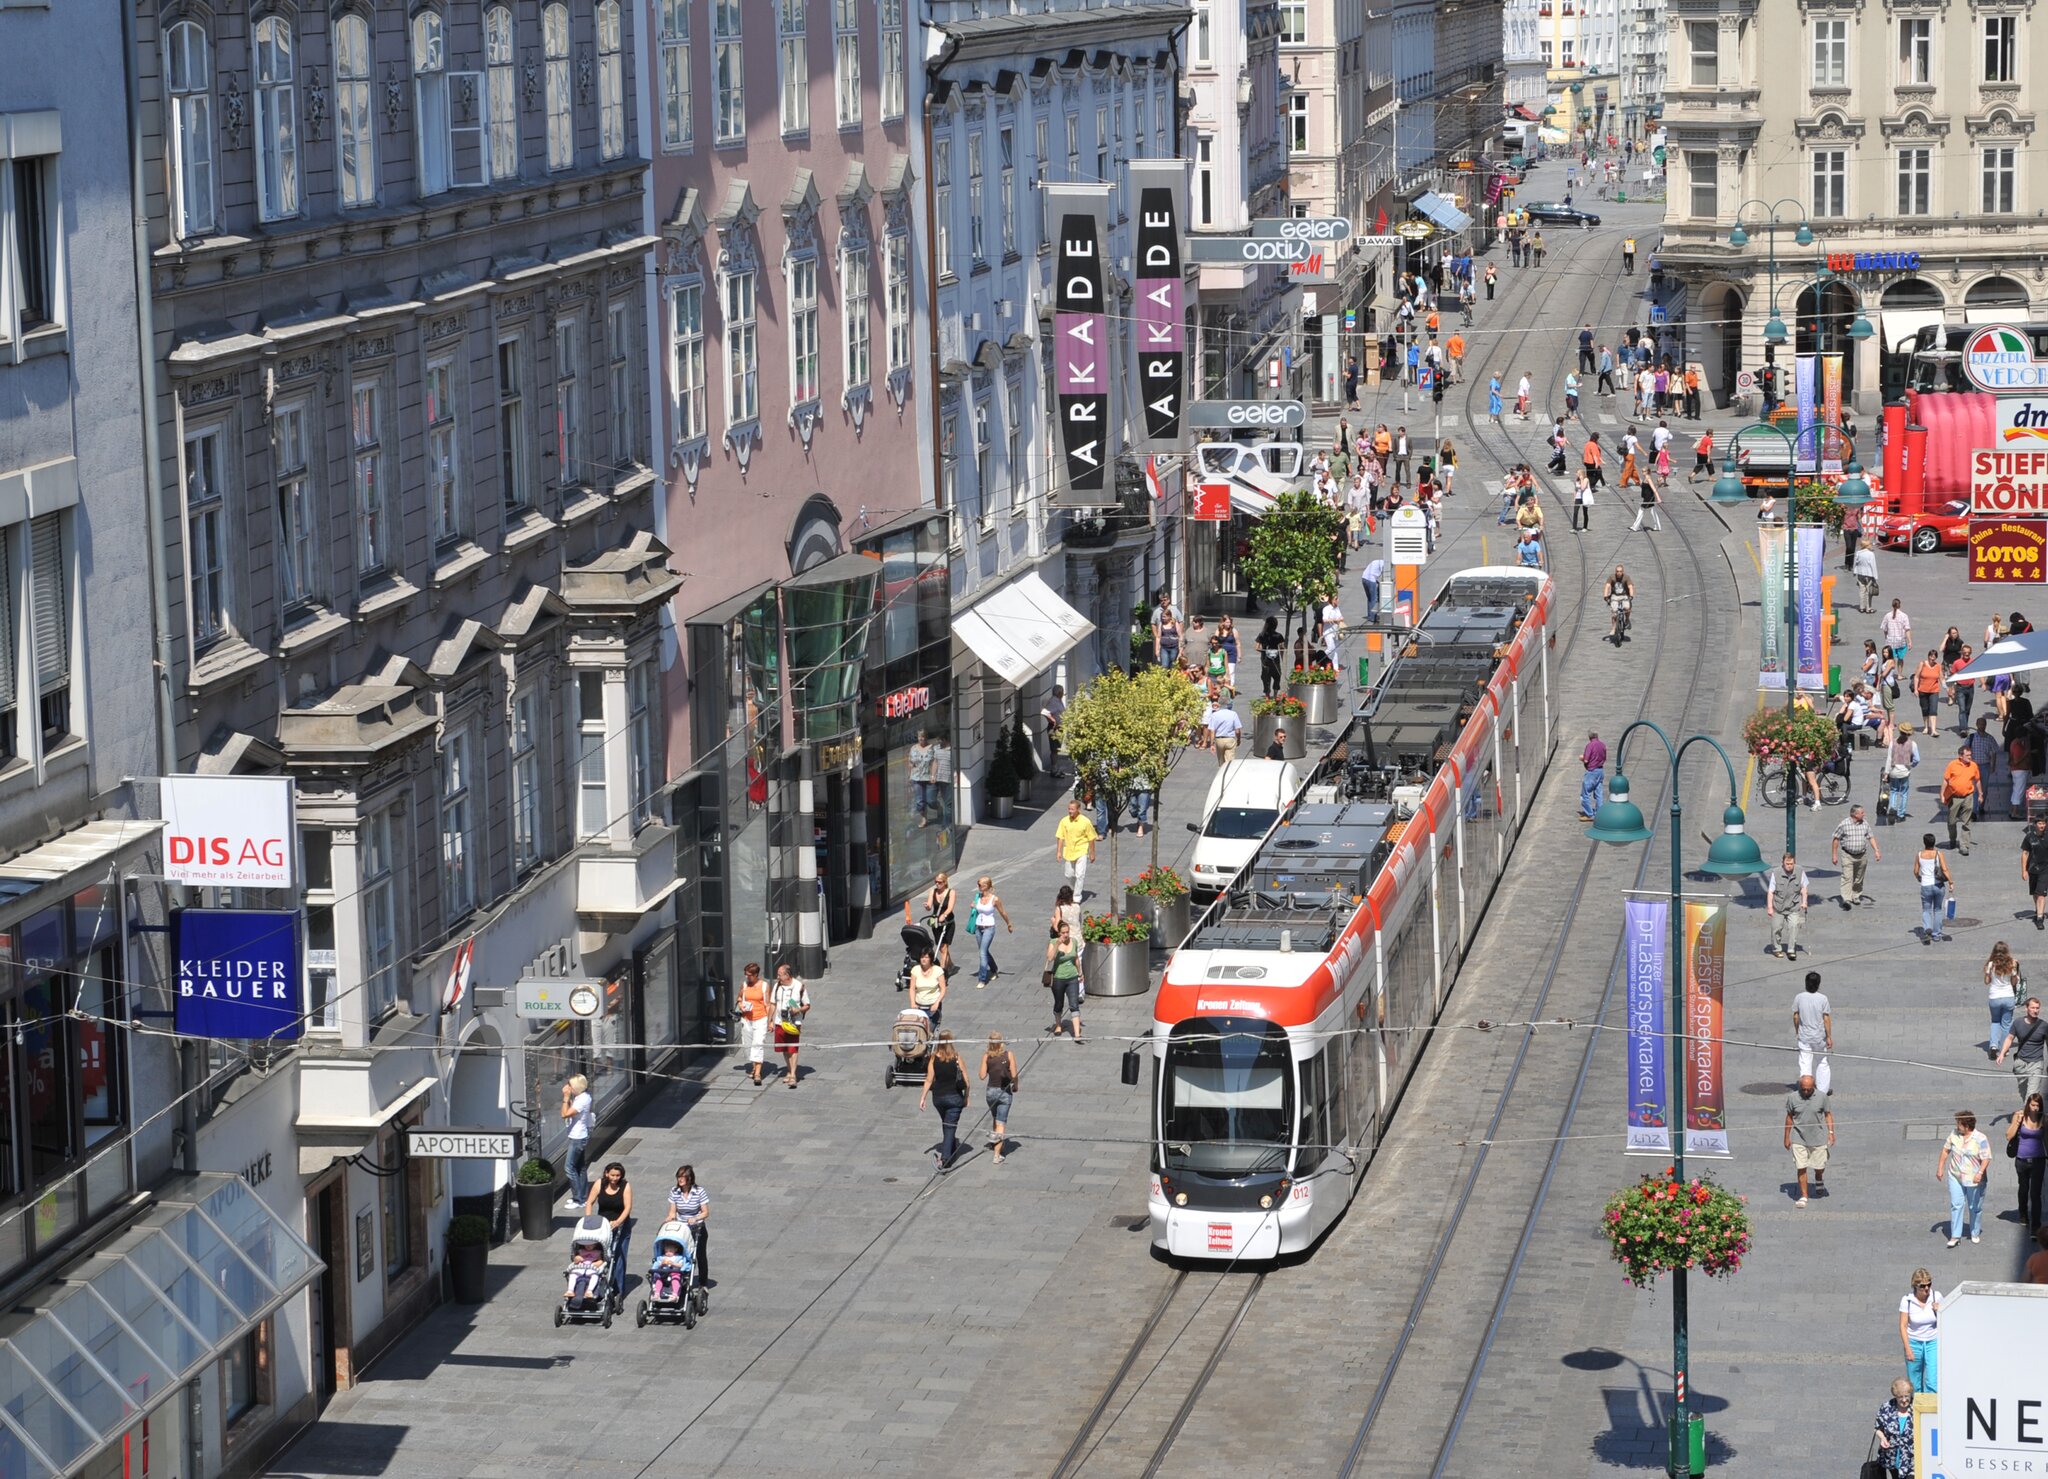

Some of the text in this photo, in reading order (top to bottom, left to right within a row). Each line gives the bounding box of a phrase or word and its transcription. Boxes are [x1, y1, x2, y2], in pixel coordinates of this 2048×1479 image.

[1243, 239, 1305, 261] optik
[1358, 237, 1402, 246] BAWAG
[1827, 251, 1920, 271] HUMANIC
[1145, 211, 1175, 418] ARKADE
[1065, 239, 1098, 466] ARKADE
[1971, 352, 2027, 364] PIZZERIA
[1982, 367, 2048, 385] VERON
[1975, 452, 2048, 476] STIEF
[1970, 527, 1994, 545] China
[2001, 523, 2046, 546] Restaurant
[1976, 546, 2039, 563] LOTOS
[169, 836, 283, 867] DIS AG
[170, 870, 286, 880] Viel mehr als Zeitarbeit.
[180, 959, 286, 979] KLEIDER
[1653, 952, 1663, 982] linzer
[181, 980, 287, 999] BAUER
[525, 1001, 562, 1010] ROLEX
[1197, 1000, 1228, 1011] Kronen
[414, 1136, 511, 1154] APOTHEKE
[1293, 1186, 1309, 1200] 012
[1965, 1457, 2033, 1472] BESSER
